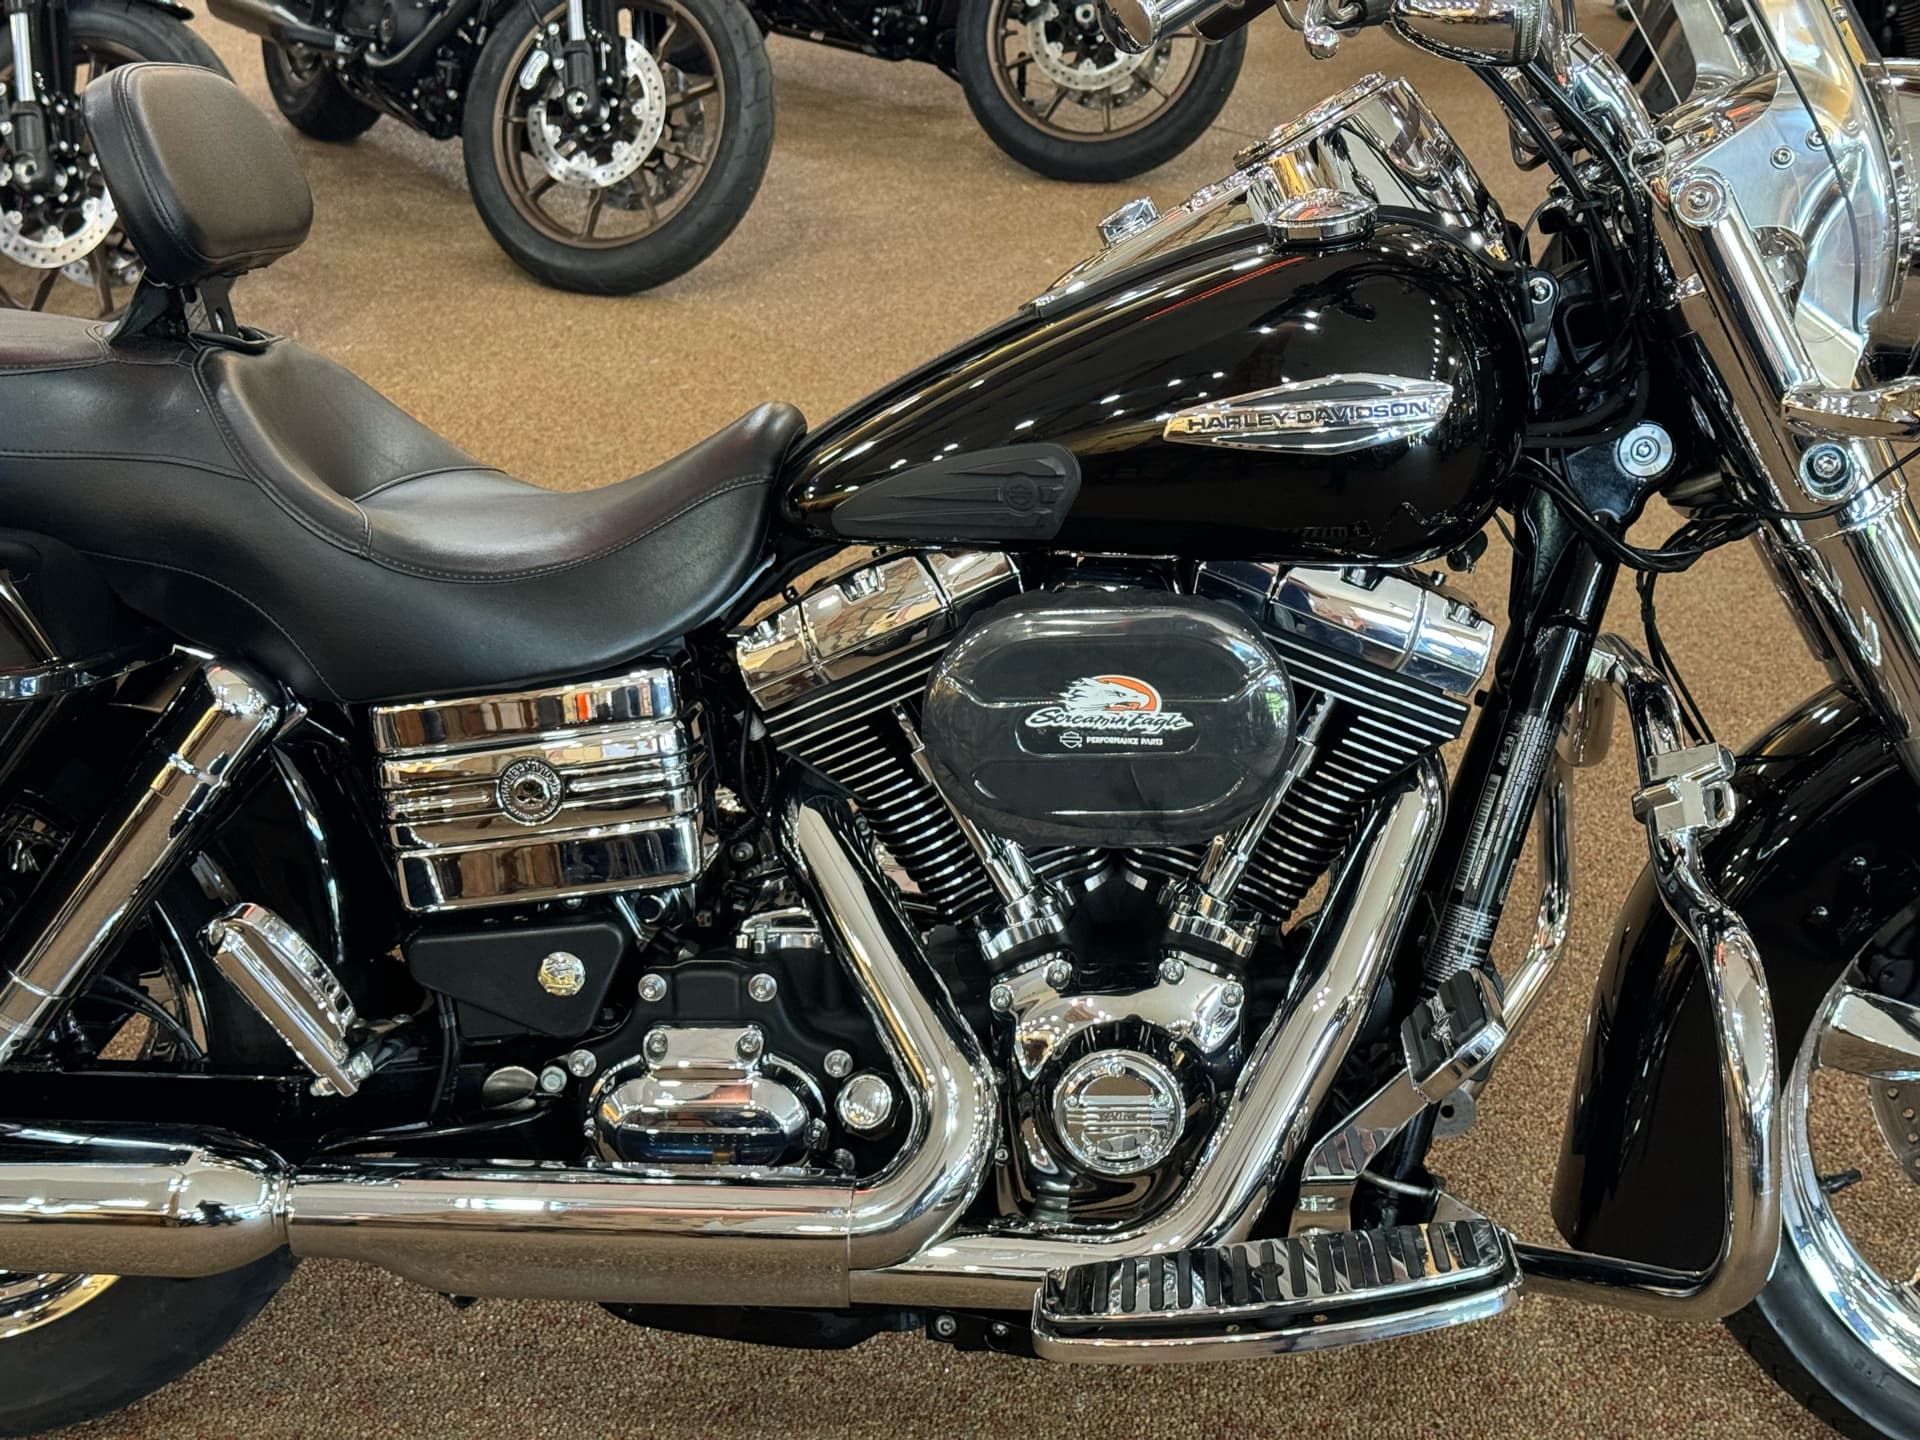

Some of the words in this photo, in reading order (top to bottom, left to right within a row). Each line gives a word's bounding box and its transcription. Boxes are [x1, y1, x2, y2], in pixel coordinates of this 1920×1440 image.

[1187, 402, 1428, 432] HARLEY-DAVIDSON
[1127, 711, 1193, 734] Eagle
[1086, 736, 1139, 745] PERFORMANCE
[1140, 737, 1163, 746] PARTS
